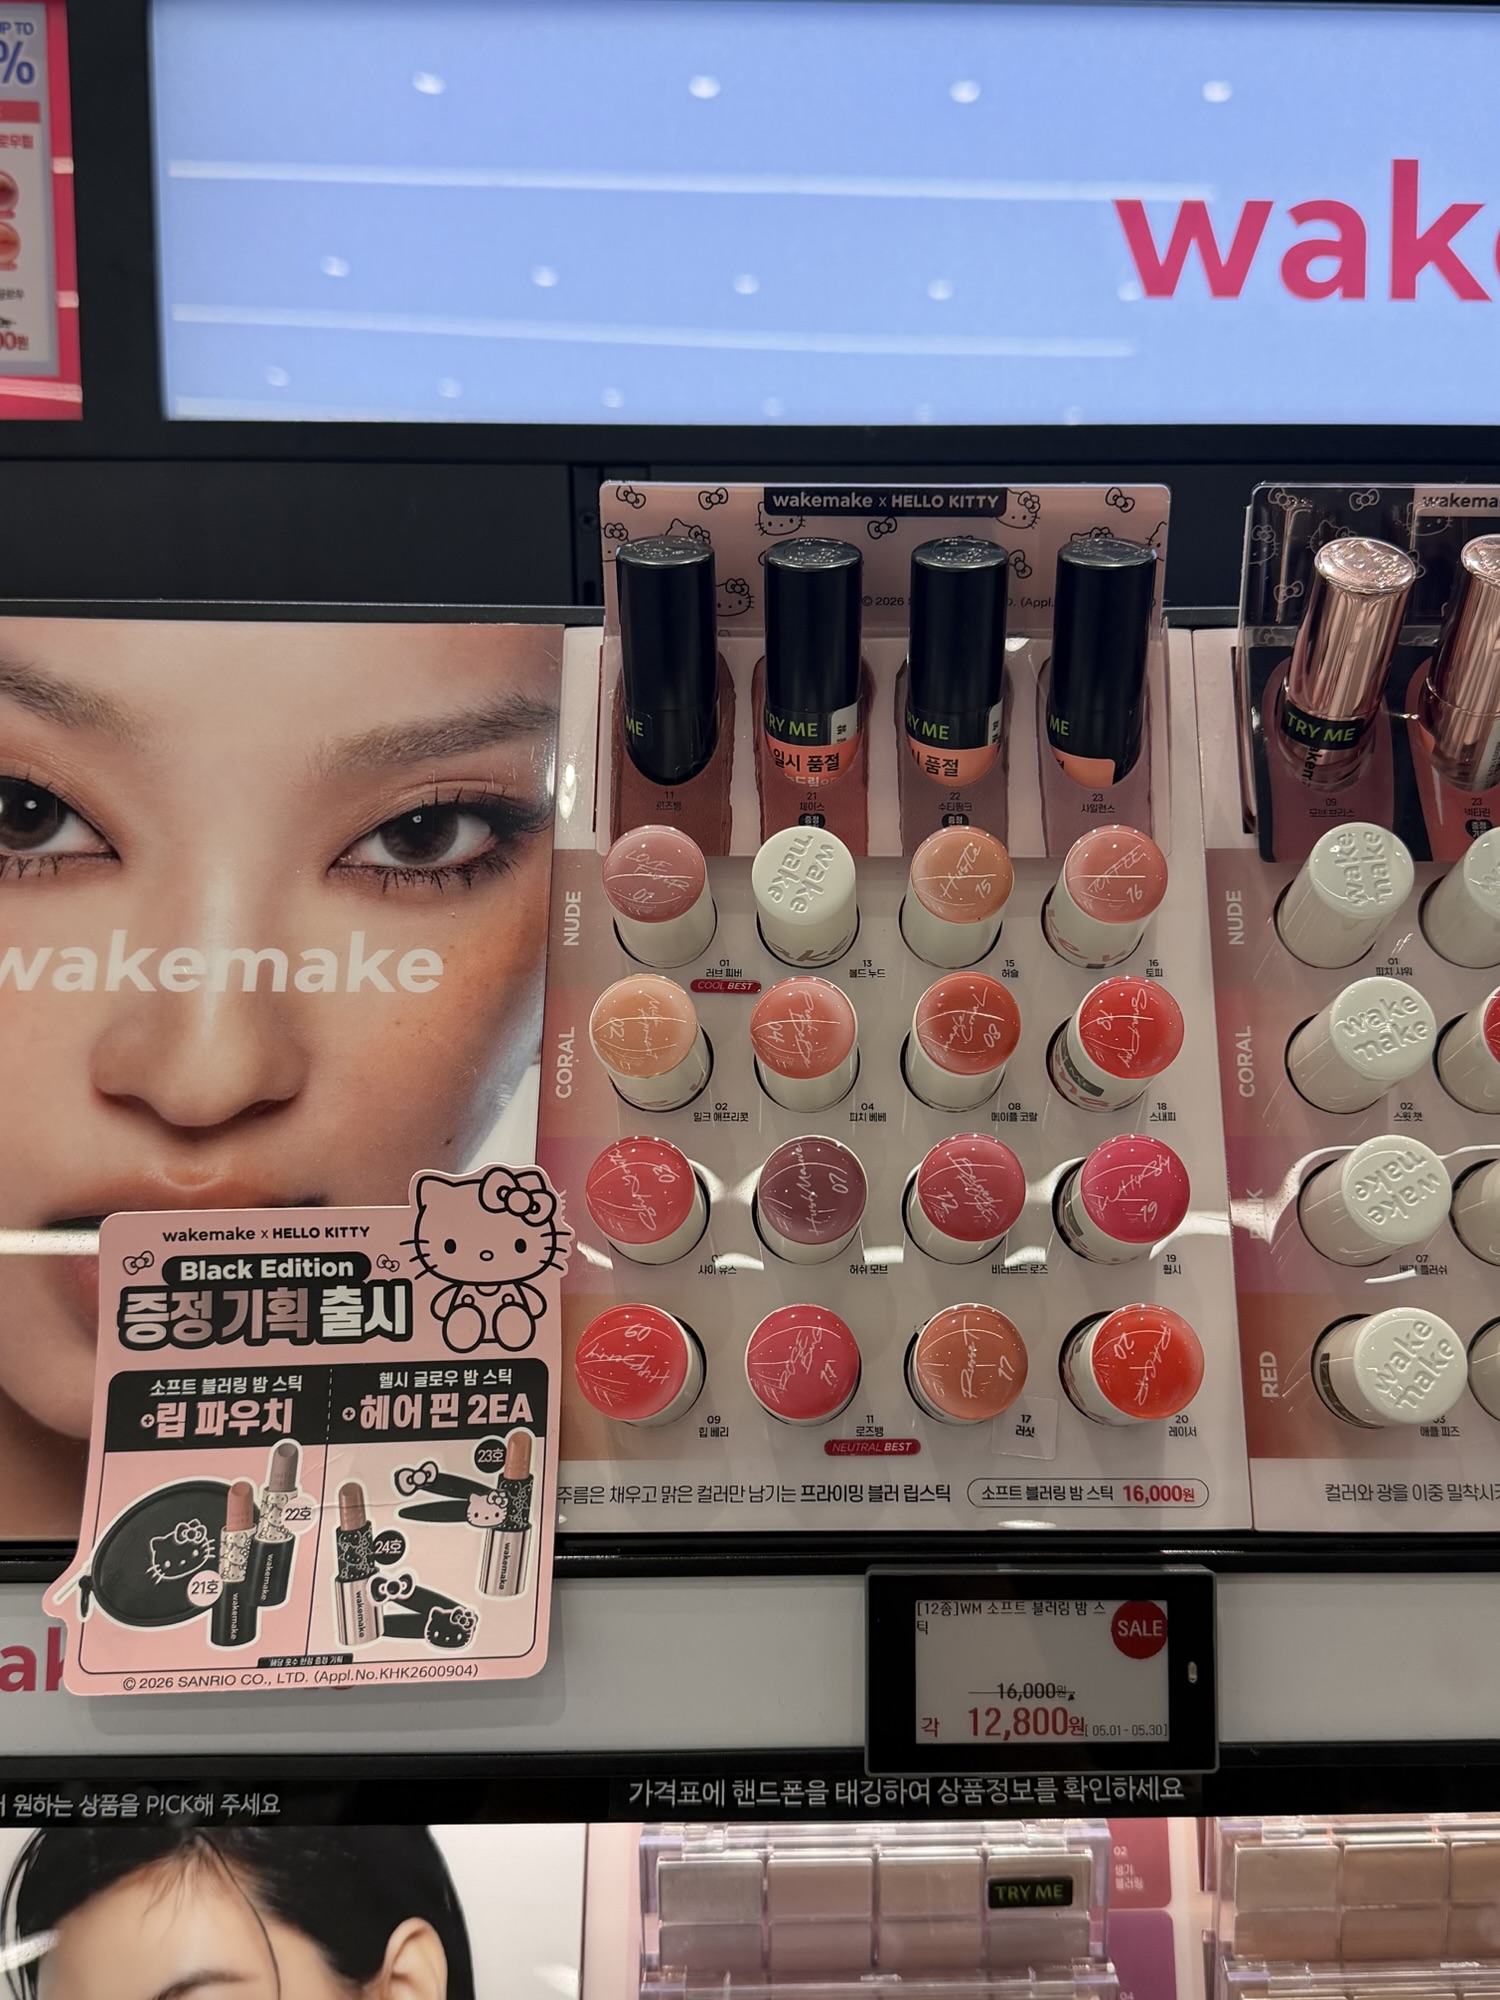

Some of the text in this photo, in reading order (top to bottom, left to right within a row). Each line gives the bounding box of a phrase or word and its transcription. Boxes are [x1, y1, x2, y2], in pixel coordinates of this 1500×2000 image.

[15, 22, 34, 35] TO
[1113, 158, 1500, 302] wak
[772, 492, 998, 509] wakemake HELLO KITTY
[789, 720, 818, 738] ME
[922, 720, 949, 740] ME
[1050, 714, 1069, 736] ME
[1287, 711, 1355, 742] TRY ME
[773, 748, 839, 773] 일시 품절
[925, 754, 959, 778] 품절
[664, 790, 675, 799] 11
[807, 791, 817, 801] 21
[949, 791, 961, 801] 22
[1092, 793, 1104, 802] 23
[1326, 798, 1337, 806] 09
[1471, 798, 1482, 806] 23
[1080, 803, 1116, 814] 사일런스
[767, 834, 816, 904] make
[789, 843, 836, 915] wake
[563, 890, 582, 947] NUDE
[1225, 889, 1245, 946] NUDE
[0, 929, 445, 993] wakemake
[719, 959, 730, 968] 01
[862, 959, 873, 968] 13
[1005, 959, 1015, 968] 15
[1149, 959, 1159, 968] 16
[1388, 957, 1399, 966] 01
[705, 968, 743, 978] 러브 피버
[868, 968, 886, 978] 누드
[1001, 968, 1019, 978] 허슬
[1145, 968, 1164, 978] 토피
[1375, 967, 1393, 977] 피치
[697, 980, 753, 991] COOL BEST
[1341, 994, 1420, 1038] wake
[1353, 1019, 1430, 1062] make
[554, 1025, 576, 1099] CORAL
[1234, 1025, 1256, 1099] CORAL
[714, 1103, 728, 1111] 02
[860, 1103, 875, 1111] 04
[1007, 1102, 1021, 1111] 08
[1157, 1102, 1167, 1111] 18
[1400, 1102, 1413, 1111] 02
[849, 1112, 887, 1122] 피치 베베
[1019, 1112, 1038, 1122] 코랄
[1149, 1112, 1176, 1122] 스내피
[162, 1226, 370, 1242] wakemake HELLO KITTY
[1166, 1254, 1176, 1263] 19
[1415, 1254, 1429, 1263] 07
[180, 1257, 354, 1281] Black Edition
[697, 1264, 737, 1275] 샤이 유스
[849, 1264, 889, 1275] 허쉬 모브
[1030, 1264, 1048, 1275] 로즈
[123, 1284, 407, 1344] 증정 기획 출시
[379, 1368, 513, 1390] 헬시 글로우 밤 스틱
[1259, 1350, 1280, 1399] RED
[150, 1374, 303, 1397] 소프트 블러링 밤 스틱
[194, 1397, 294, 1438] 파우치
[360, 1392, 534, 1431] 헤어 핀 2EA
[1021, 1414, 1031, 1424] 17
[1175, 1414, 1189, 1424] 20
[706, 1415, 721, 1425] 09
[865, 1415, 874, 1424] 11
[710, 1426, 729, 1438] 베리
[855, 1426, 884, 1437] 로즈뱅
[1015, 1425, 1035, 1437] 러싯
[1168, 1426, 1197, 1437] 레이서
[1419, 1426, 1460, 1437] 애플 피즈
[831, 1441, 912, 1452] NEUTRAL BEST
[477, 1448, 504, 1464] 23호
[558, 1484, 951, 1504] 주름은 채우고 맑은 컬러만 남기는 프라이밍 블러 립스틱
[981, 1484, 1196, 1504] 소프트 블러링 밤 스틱 16,000원
[1325, 1483, 1444, 1502] 컬러와 광을 이중
[284, 1506, 313, 1522] 22호
[374, 1539, 403, 1555] 24호
[498, 1541, 511, 1590] wakemake
[259, 1552, 274, 1601] wakemake
[190, 1579, 220, 1595] 21호
[355, 1590, 366, 1639] wakemake
[986, 1601, 1027, 1615] 소프트
[1031, 1601, 1070, 1616] 블러링
[1074, 1601, 1088, 1616] 밤
[1092, 1601, 1107, 1615] 스
[916, 1620, 929, 1635] 틱
[1117, 1619, 1163, 1637] SALE
[139, 1664, 479, 1690] 2026 SANRIO CO., LTD. (Appl.No.KHK2600904)
[996, 1682, 1068, 1701] 16,000원
[921, 1706, 1086, 1741] 각 12,800원
[629, 1774, 1185, 1808] 가격표에 핸드폰을 태깅하여 상품정보를 확인하세요
[13, 1793, 73, 1818] 원하는
[78, 1793, 141, 1817] 상품을
[220, 1793, 282, 1817] 주세요
[1113, 1846, 1127, 1856] 02
[994, 1884, 1064, 1900] TRY ME
